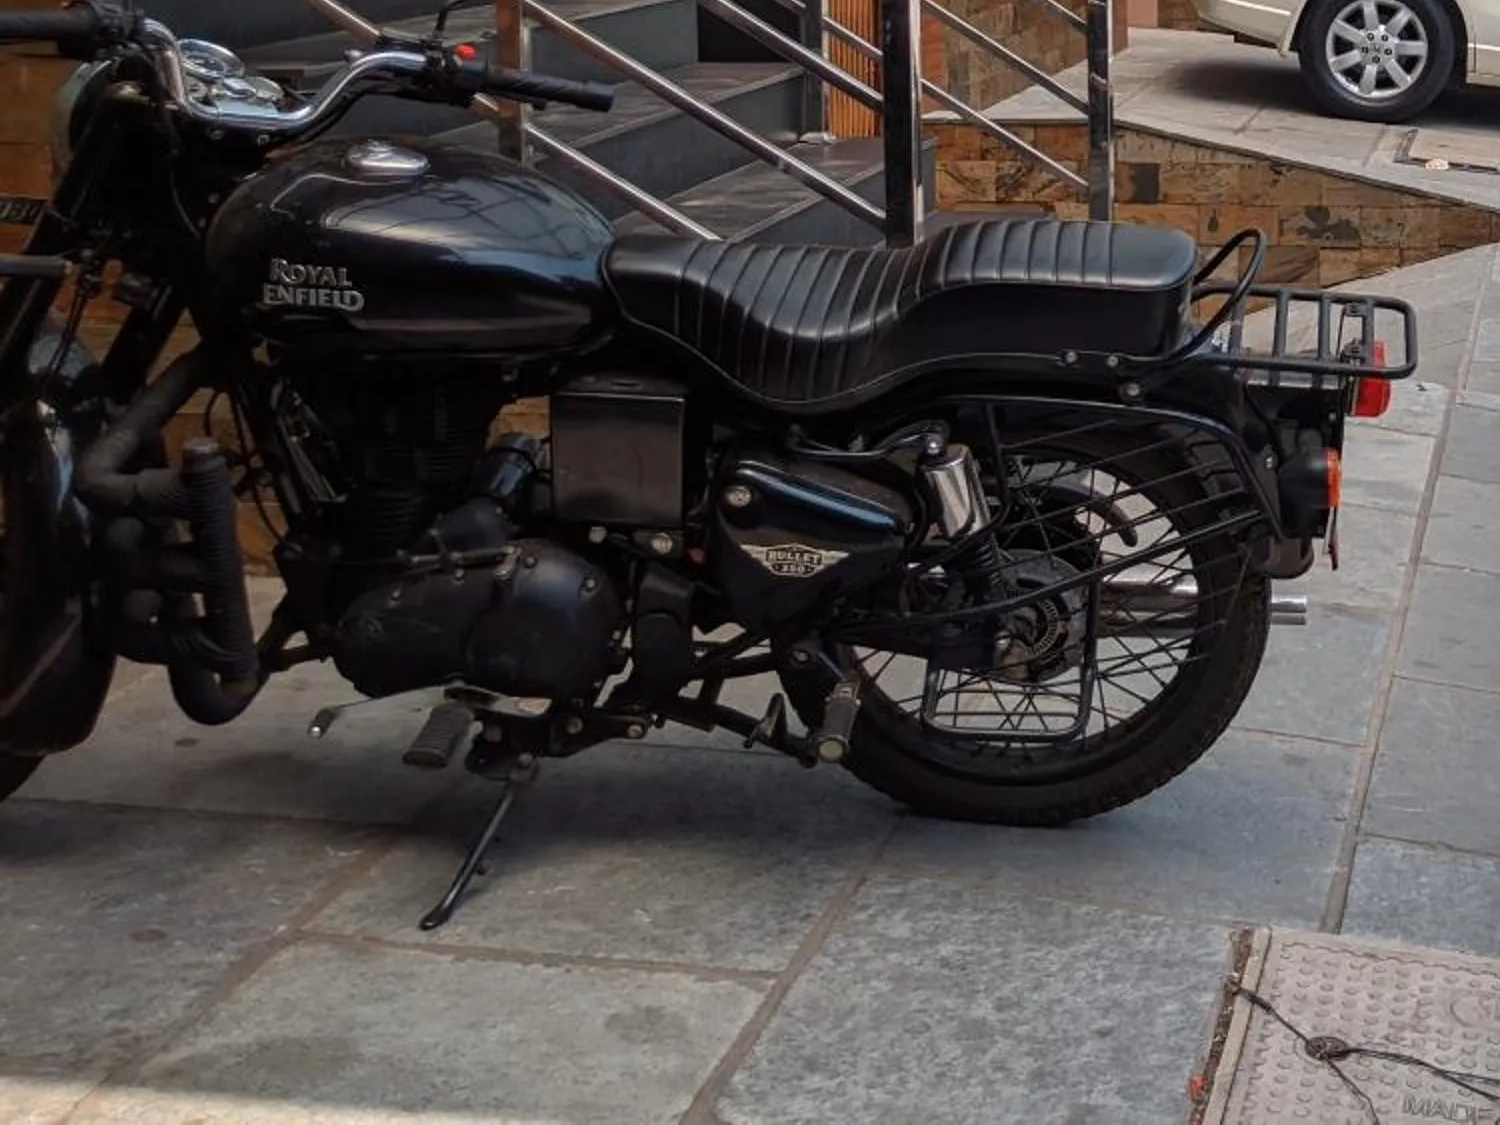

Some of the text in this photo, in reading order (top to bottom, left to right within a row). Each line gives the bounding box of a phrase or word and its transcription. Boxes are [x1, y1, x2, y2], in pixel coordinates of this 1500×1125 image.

[270, 257, 353, 289] ROYAL
[262, 283, 365, 312] ENFIELD
[767, 550, 821, 565] BULLET
